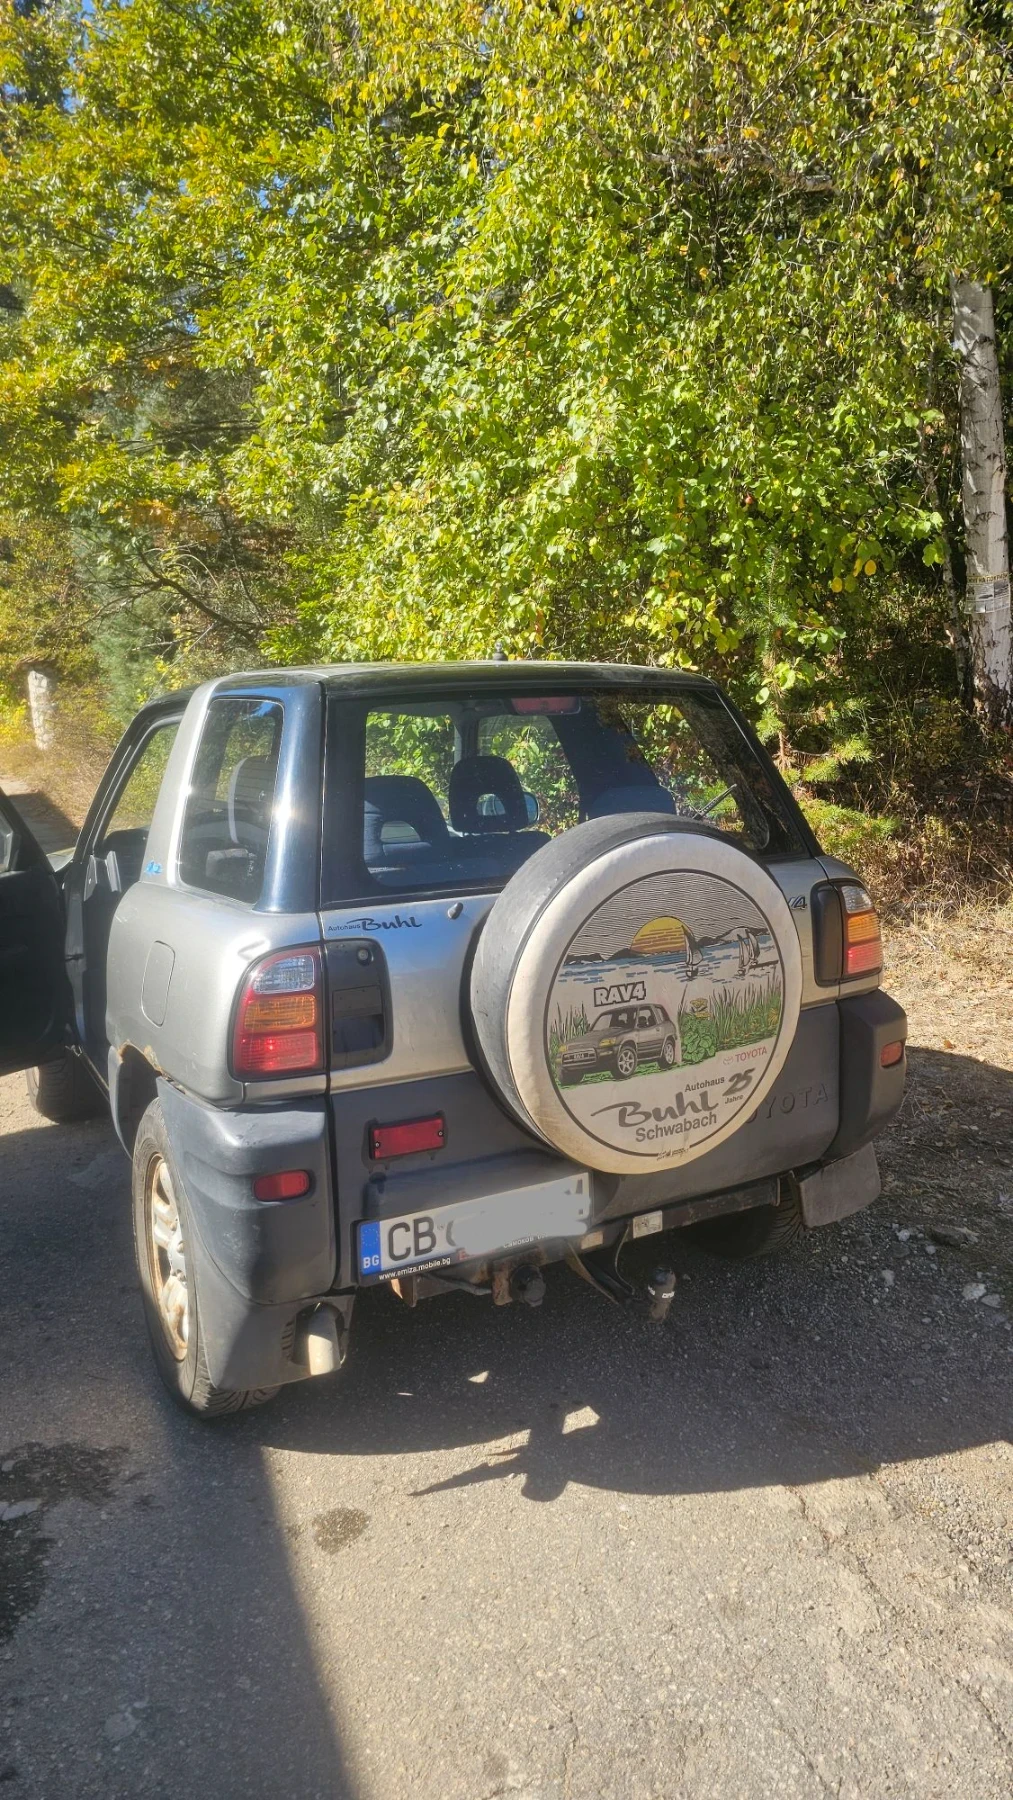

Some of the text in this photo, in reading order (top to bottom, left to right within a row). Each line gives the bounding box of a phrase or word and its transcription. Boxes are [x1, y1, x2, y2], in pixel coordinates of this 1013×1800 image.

[346, 915, 422, 931] Buhl
[594, 981, 646, 1007] RAV4
[735, 1046, 767, 1062] TOYOTA
[685, 1076, 725, 1092] Autohaus
[722, 1067, 756, 1096] 25
[725, 1094, 744, 1104] Jahre
[590, 1091, 719, 1127] Buhl
[635, 1112, 717, 1142] Schwabach
[363, 1255, 380, 1269] BG
[379, 1257, 451, 1280] www.emiza.mobile.bg
